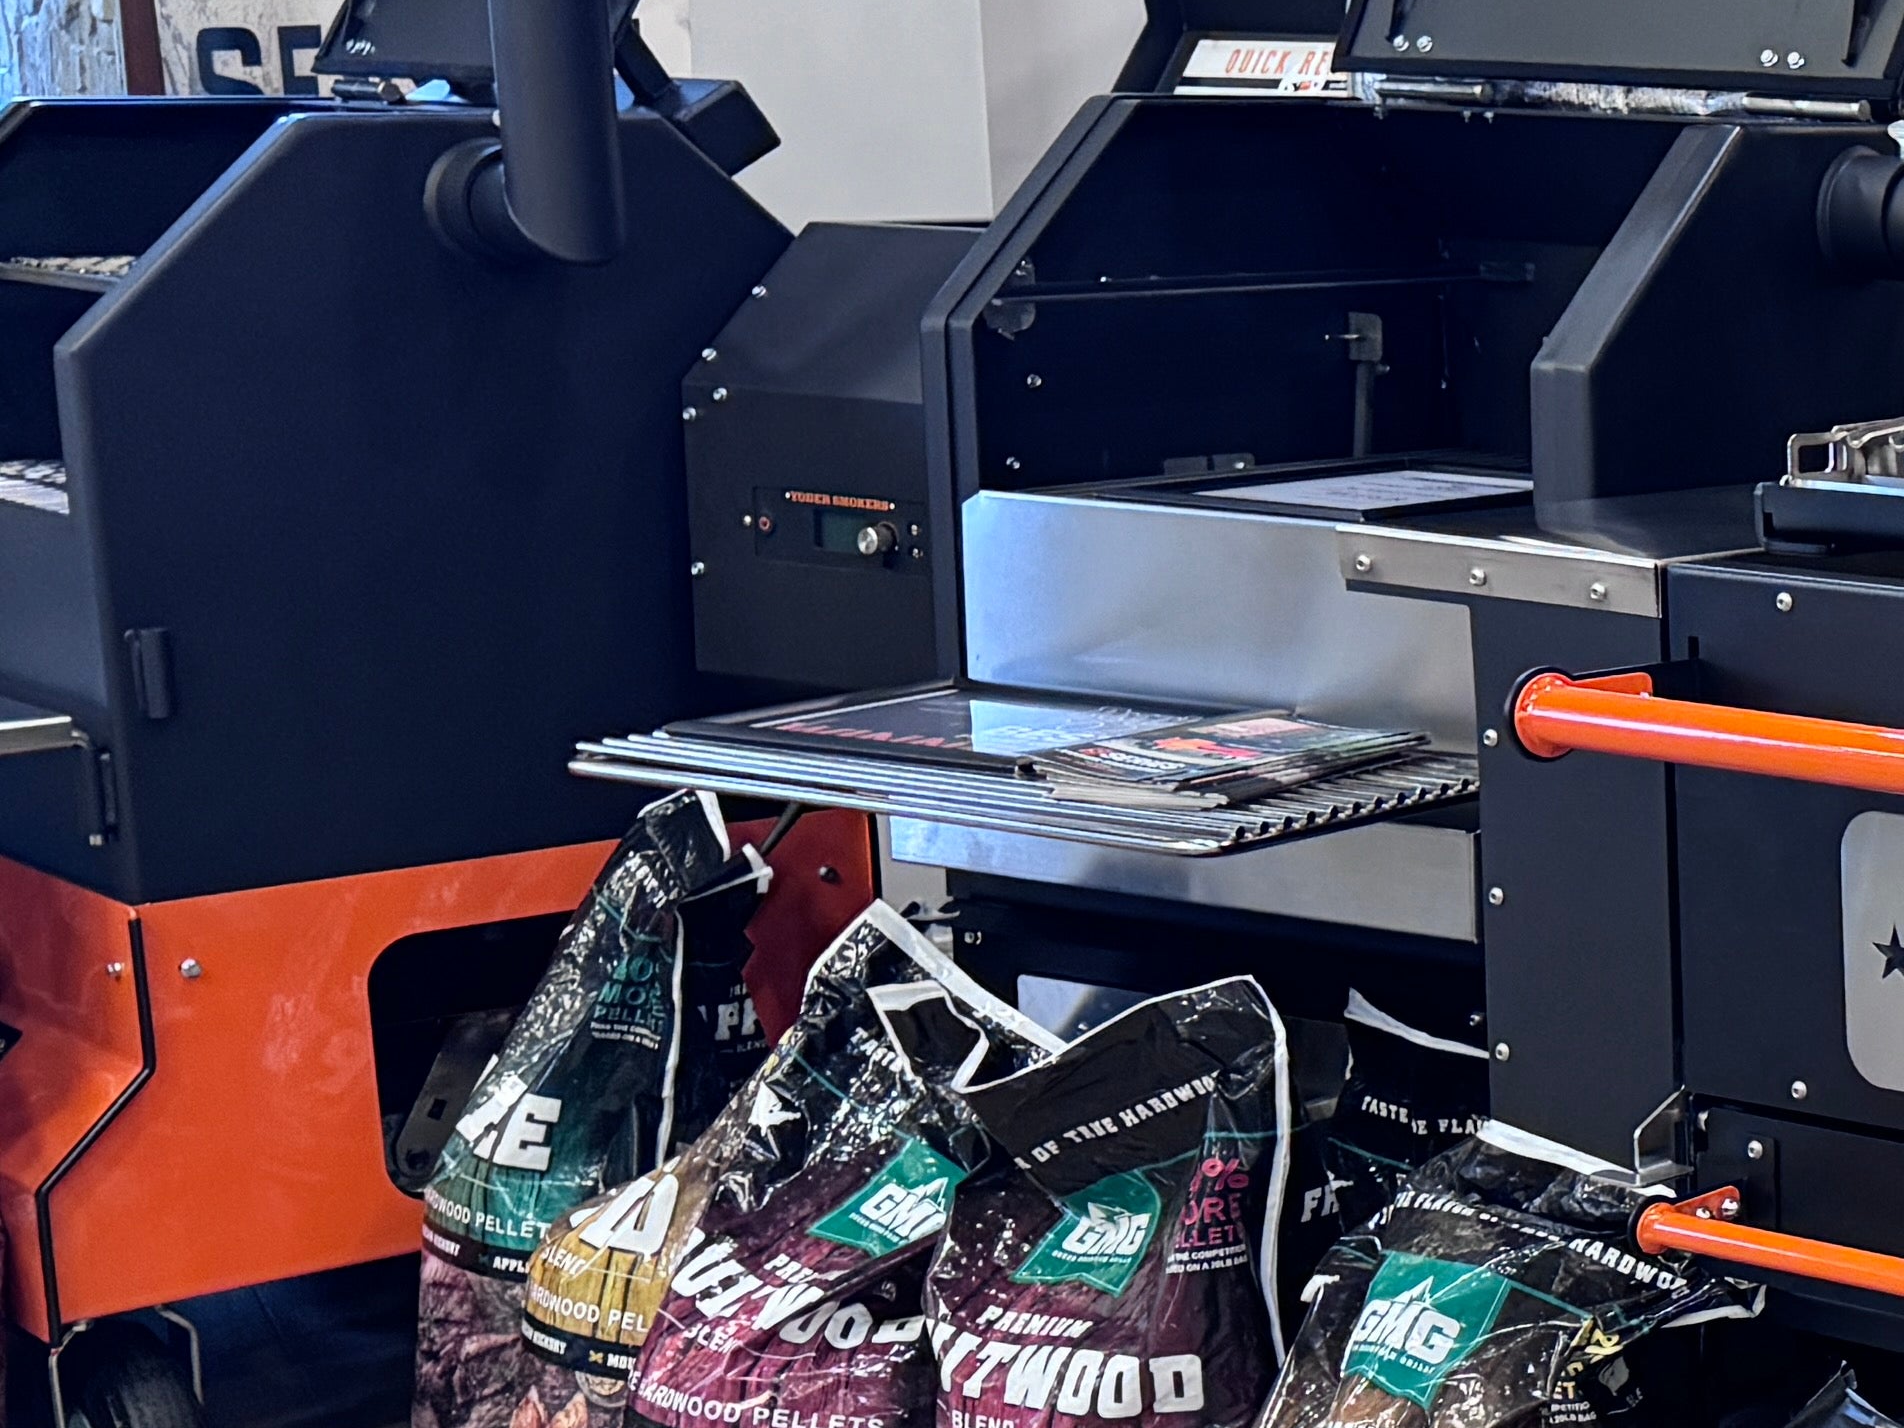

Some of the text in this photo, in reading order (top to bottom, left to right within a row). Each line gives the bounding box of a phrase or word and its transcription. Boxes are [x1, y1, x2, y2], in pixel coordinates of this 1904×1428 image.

[1225, 49, 1290, 74] QUICK
[1062, 1204, 1152, 1256] GMG
[975, 1305, 1095, 1339] PREMIUM
[1353, 1299, 1461, 1365] GMG
